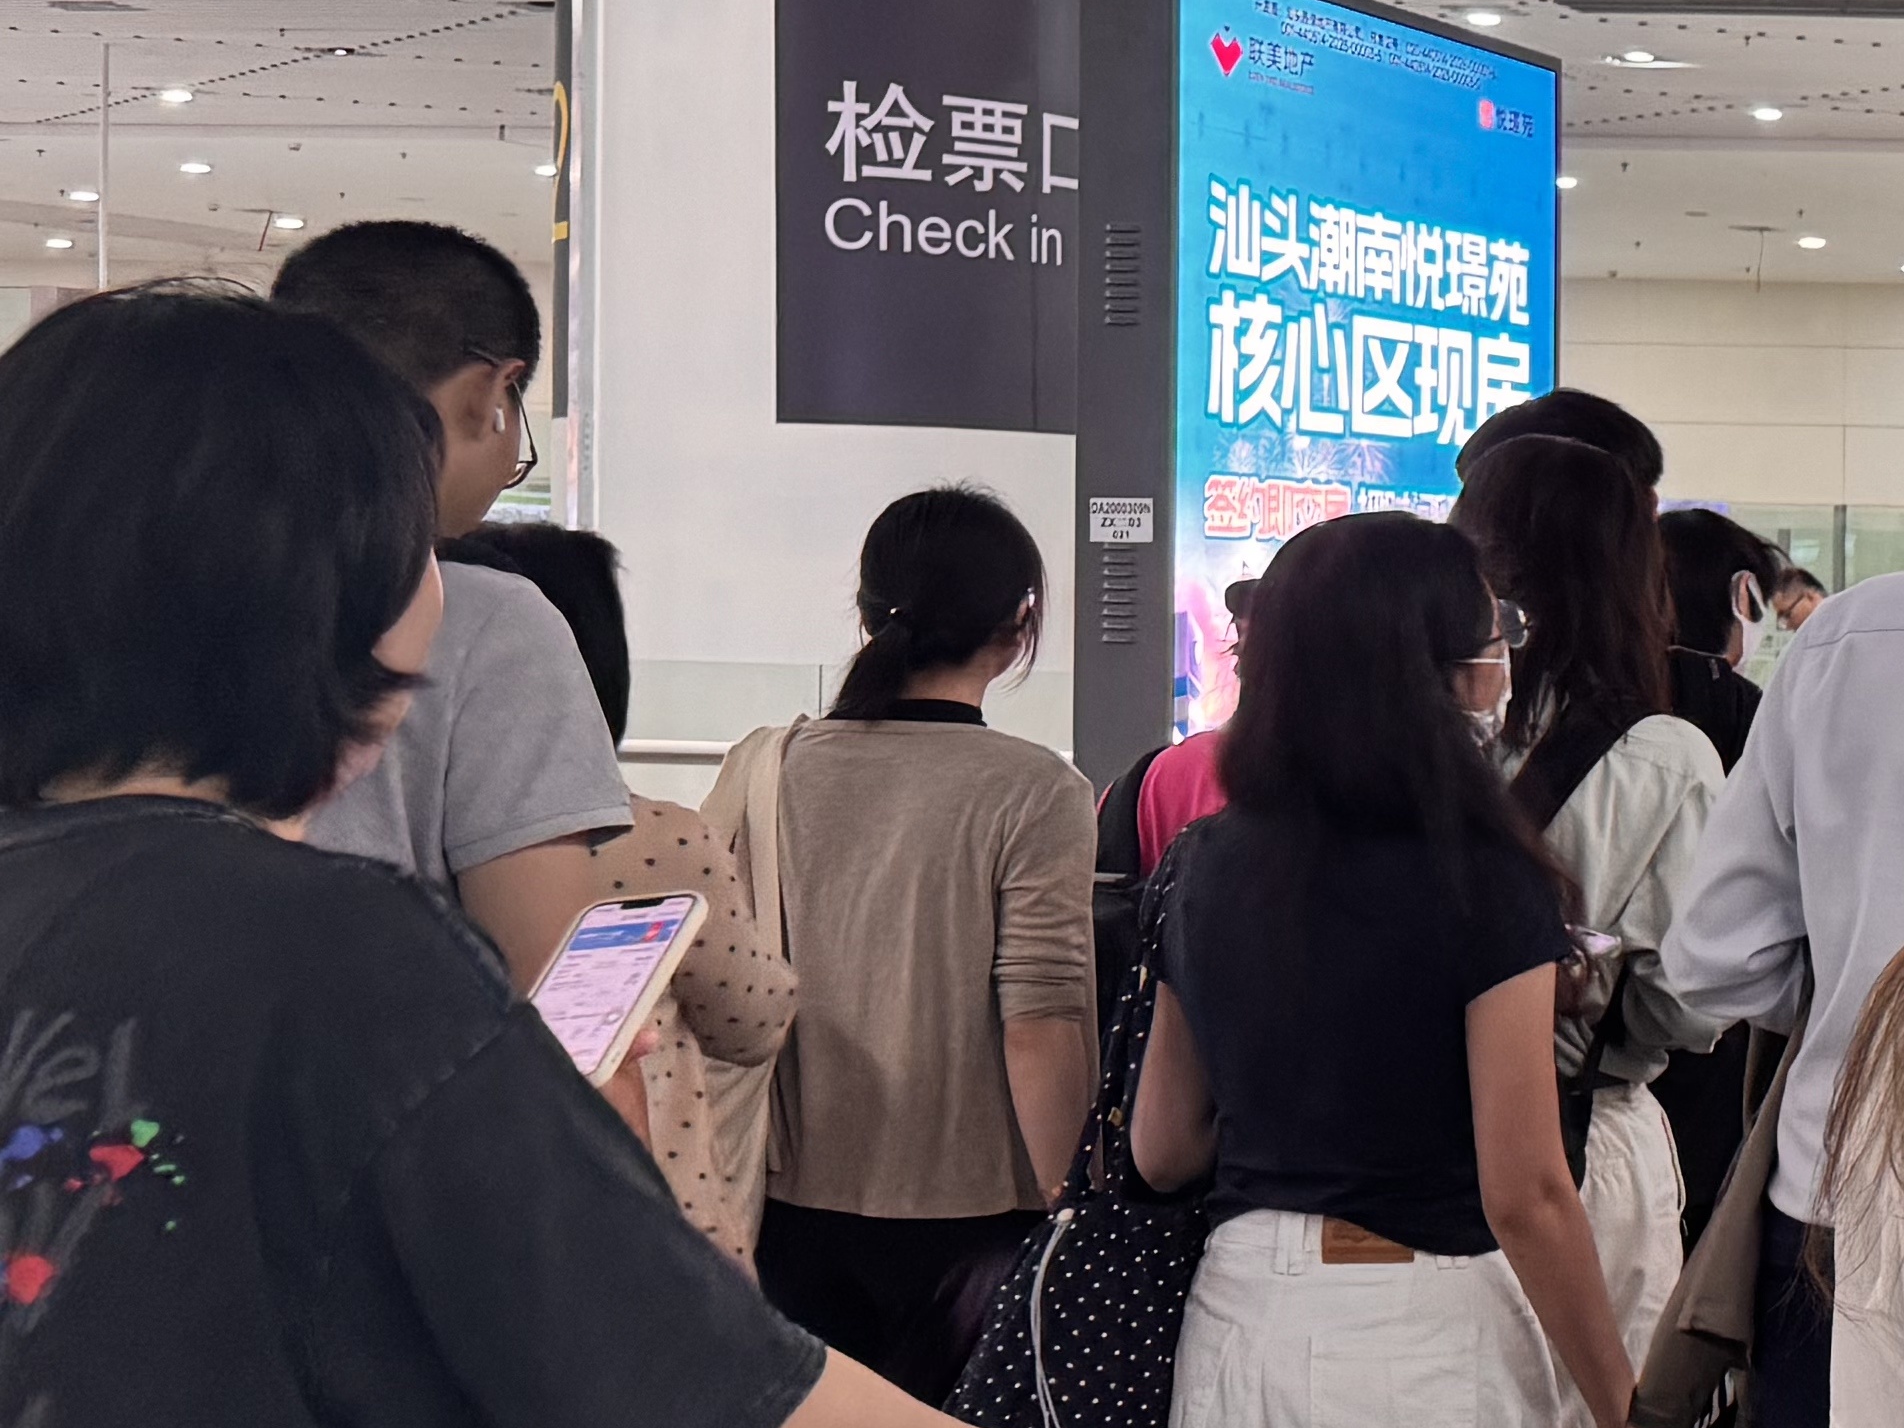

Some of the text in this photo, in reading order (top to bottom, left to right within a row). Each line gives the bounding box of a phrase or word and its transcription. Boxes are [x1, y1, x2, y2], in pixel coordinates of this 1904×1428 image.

[824, 198, 1063, 266] Check in
[1208, 177, 1531, 326] 汕头潮南悦璟苑
